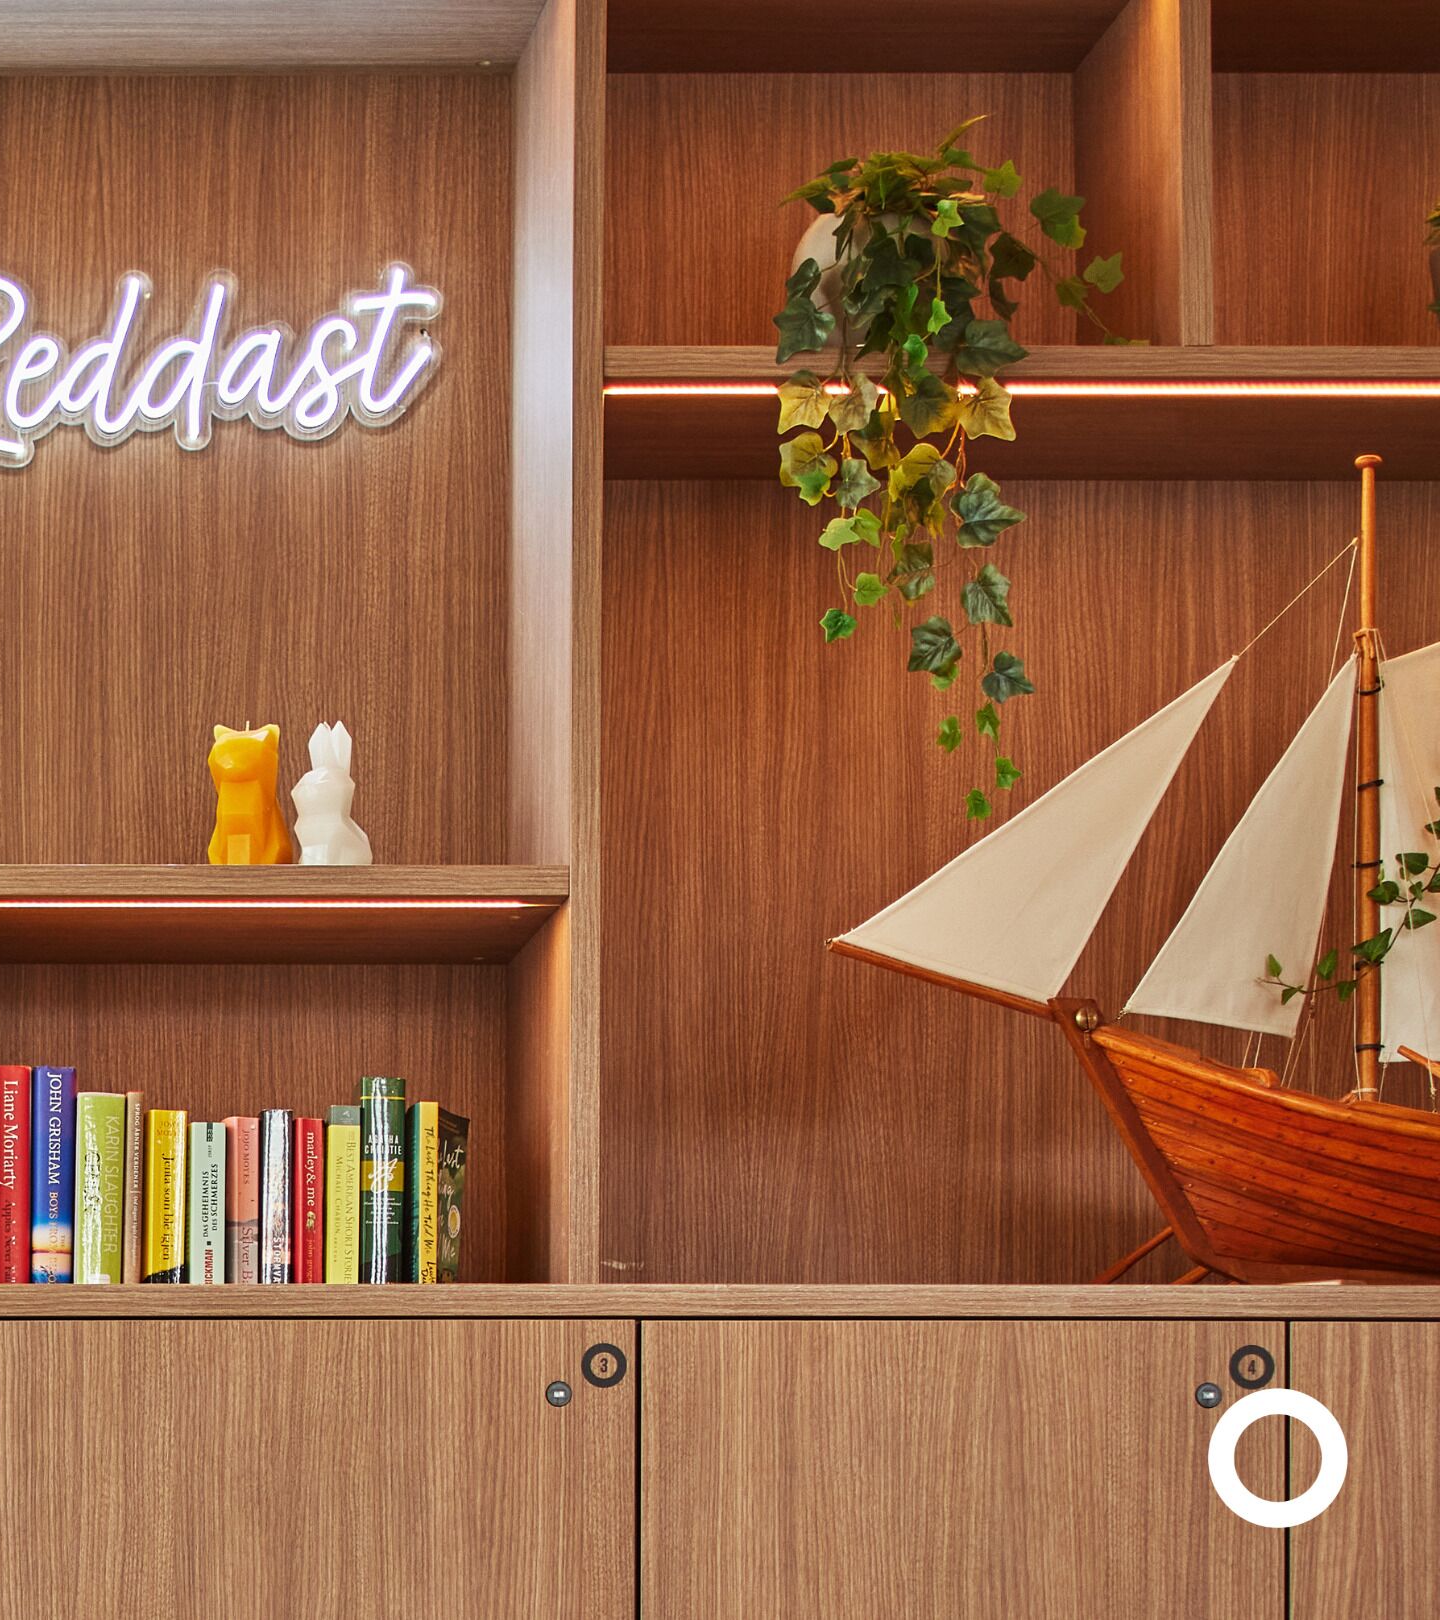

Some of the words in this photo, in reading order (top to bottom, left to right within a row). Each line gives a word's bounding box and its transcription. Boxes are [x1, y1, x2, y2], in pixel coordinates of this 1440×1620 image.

[3, 1080, 19, 1120] Liane
[47, 1072, 62, 1113] JOHN
[48, 1117, 61, 1185] GRISHAM
[105, 1116, 120, 1162] KARIN
[242, 1129, 250, 1151] JOJO
[305, 1132, 317, 1172] marley
[0, 1124, 18, 1189] Moriarty
[162, 1153, 174, 1185] Jenta
[210, 1163, 218, 1216] SCHMERZES
[306, 1173, 316, 1184] &
[49, 1192, 58, 1219] BOYS
[104, 1165, 119, 1253] SLAUGHTER
[163, 1188, 171, 1211] som
[307, 1187, 314, 1206] me
[2, 1200, 16, 1232] Apples
[163, 1214, 172, 1230] ble
[161, 1233, 172, 1261] igjen
[241, 1227, 251, 1266] Silver
[345, 1217, 354, 1248] SHORT
[5, 1235, 15, 1262] Never
[307, 1239, 315, 1258] john
[600, 1358, 608, 1373] 3
[1248, 1360, 1256, 1375] 4
